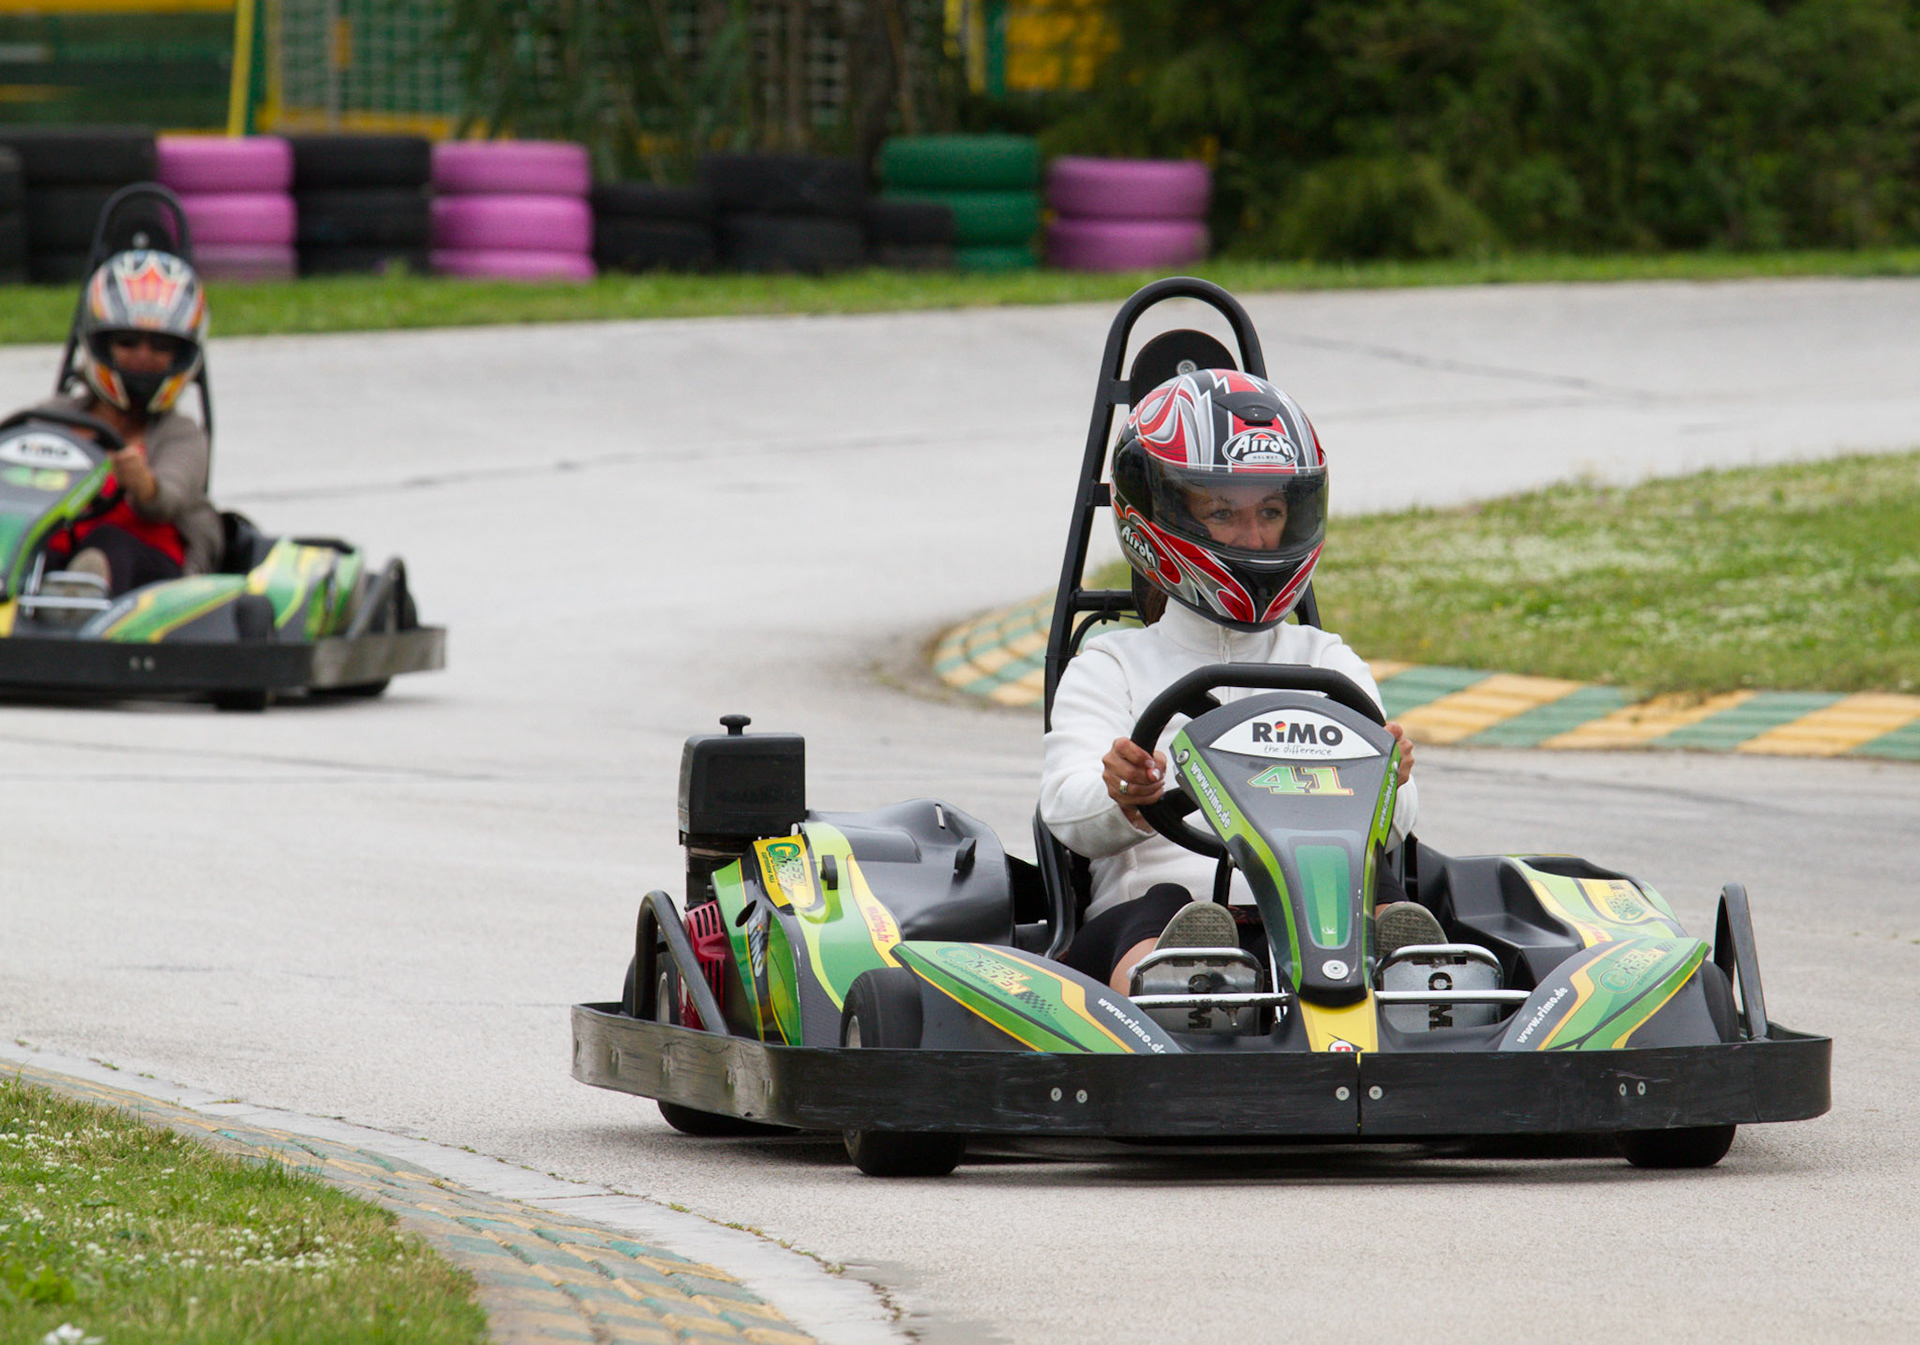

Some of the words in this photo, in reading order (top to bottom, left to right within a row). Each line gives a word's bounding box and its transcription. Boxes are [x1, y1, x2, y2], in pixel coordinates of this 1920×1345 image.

[1230, 435, 1295, 458] Airoh
[1121, 525, 1156, 568] Airoh
[1264, 744, 1280, 754] the
[1283, 744, 1333, 756] difference
[1189, 760, 1232, 830] www.rimo.de
[1247, 765, 1354, 796] 41
[1516, 987, 1569, 1043] www.rimo.de
